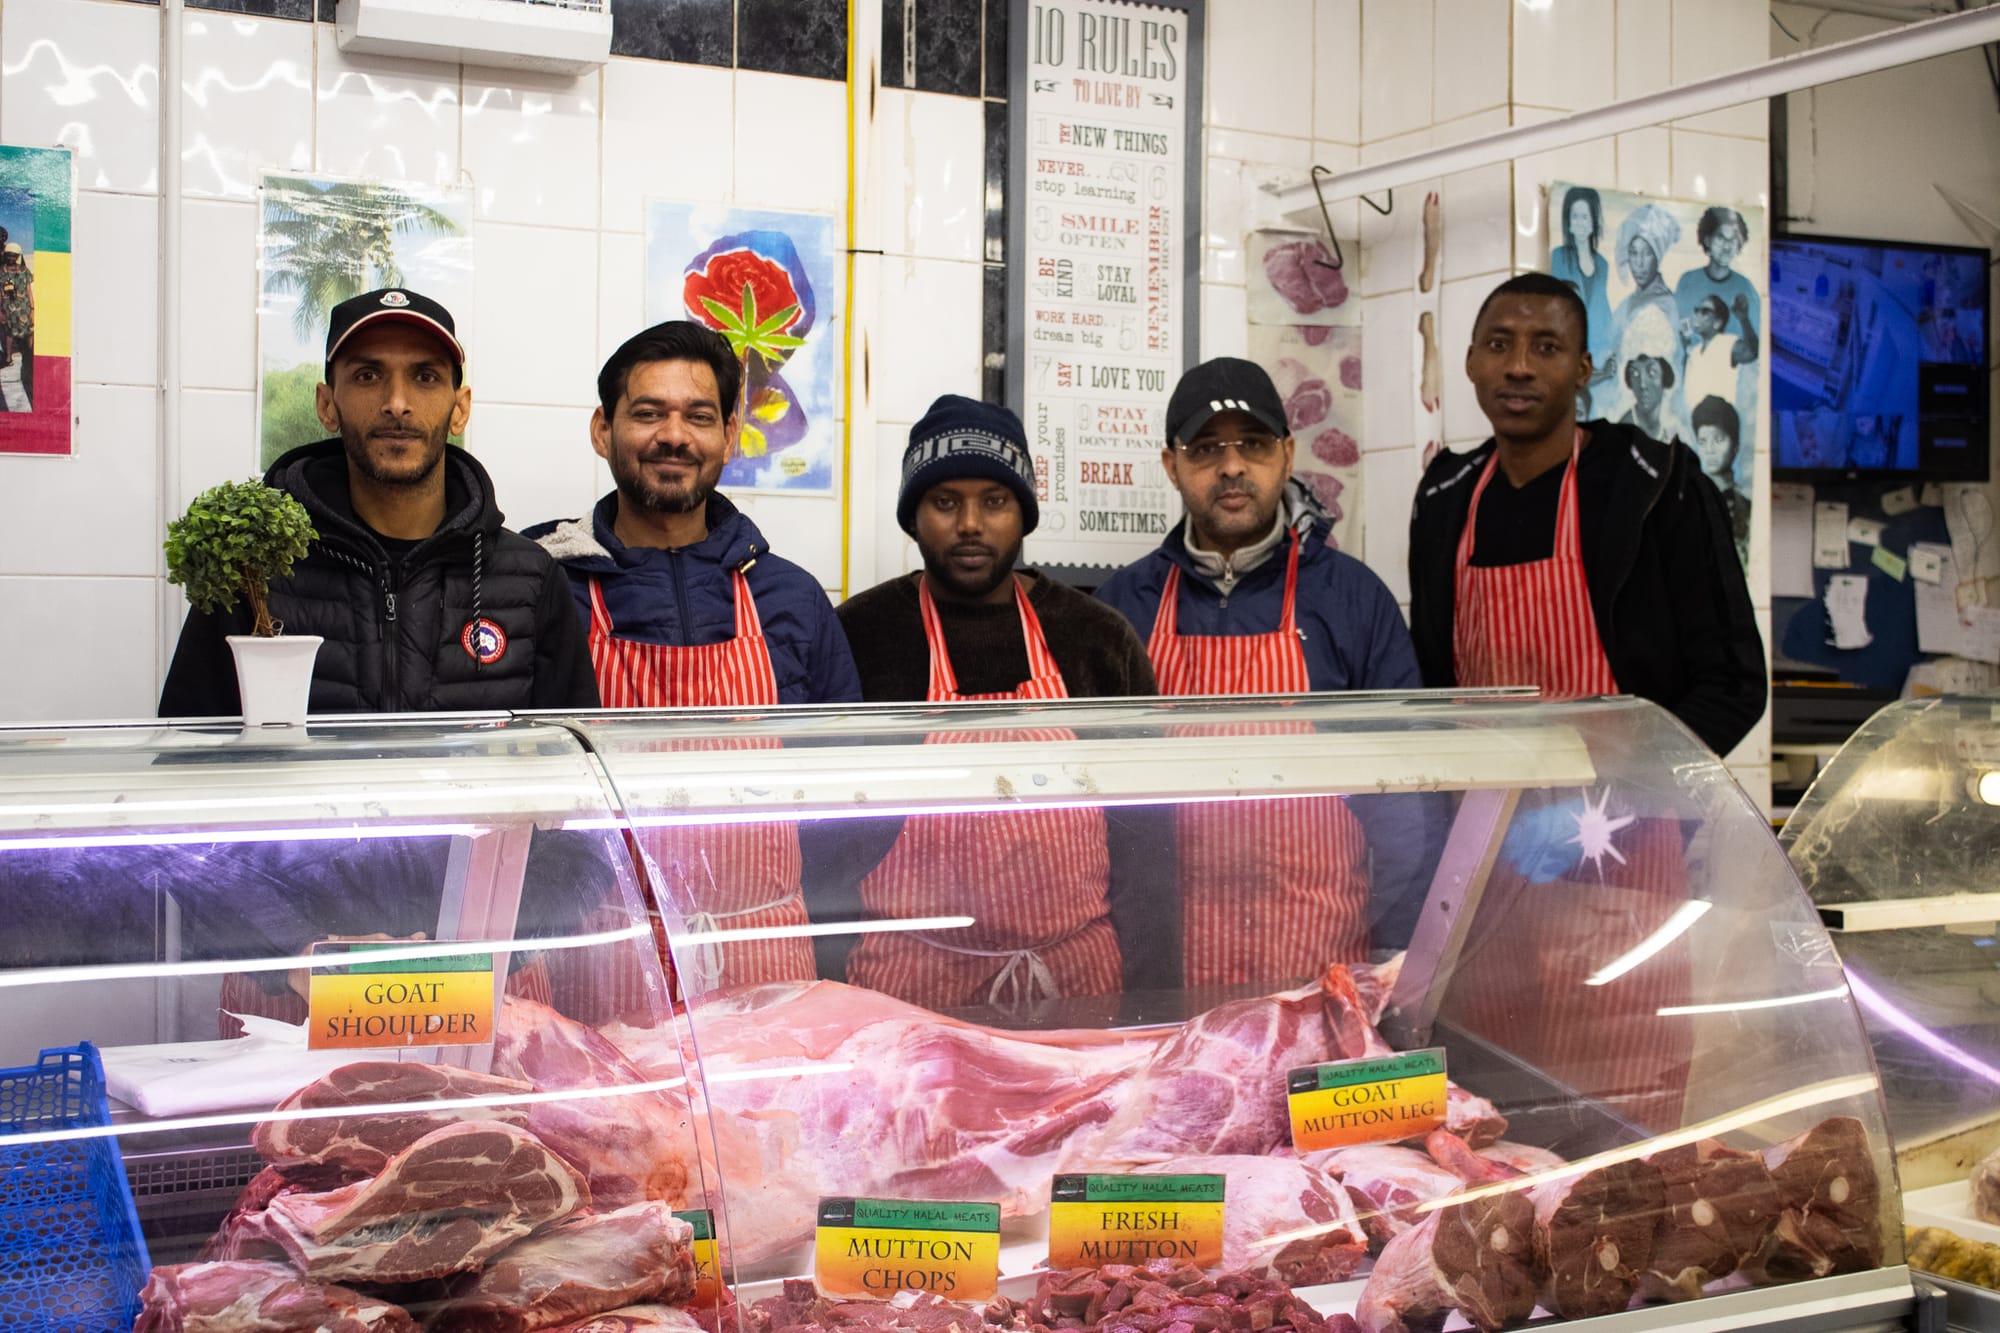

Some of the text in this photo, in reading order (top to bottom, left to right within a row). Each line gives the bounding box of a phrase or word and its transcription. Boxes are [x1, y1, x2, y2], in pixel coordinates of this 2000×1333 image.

[1034, 5, 1177, 82] 10 RULES
[1073, 78, 1141, 109] TO LIVE BY
[1059, 123, 1168, 155] TRY NEW THINGS
[1035, 179, 1136, 204] stop learning
[1061, 212, 1140, 236] SMILE
[1060, 232, 1127, 250] OFTEN
[1039, 258, 1055, 277] BE
[1057, 259, 1073, 298] KIND
[1097, 265, 1131, 283] STAY
[1148, 205, 1161, 350] REMEMBER
[1097, 284, 1136, 304] LOYAL
[1035, 310, 1066, 324] WORK
[1033, 327, 1104, 348] dream big
[1058, 362, 1165, 392] SAY I LOVE YOU
[1098, 407, 1147, 420] STAY
[1097, 421, 1149, 435] CALM
[1035, 402, 1050, 502] KEEP your
[1079, 436, 1120, 447] DON'T
[1052, 427, 1068, 502] promises
[1080, 461, 1134, 486] BREAK
[1079, 510, 1168, 535] SOMETIMES
[364, 982, 445, 1005] GOAT
[326, 1013, 478, 1039] SHOULDER
[1368, 1063, 1399, 1074] HALAL
[1404, 1057, 1436, 1069] MEATS
[1333, 1082, 1401, 1107] GOAT
[1303, 1101, 1435, 1134] MUTTON LEG
[1088, 1183, 1216, 1193] QUALITY HALAL MEATS
[856, 1208, 991, 1223] QUALITY HALAL MEATS
[1100, 1211, 1181, 1231] FRESH
[848, 1238, 974, 1262] MUTTON
[1079, 1240, 1198, 1260] MUTTON
[862, 1268, 956, 1292] CHOPS
